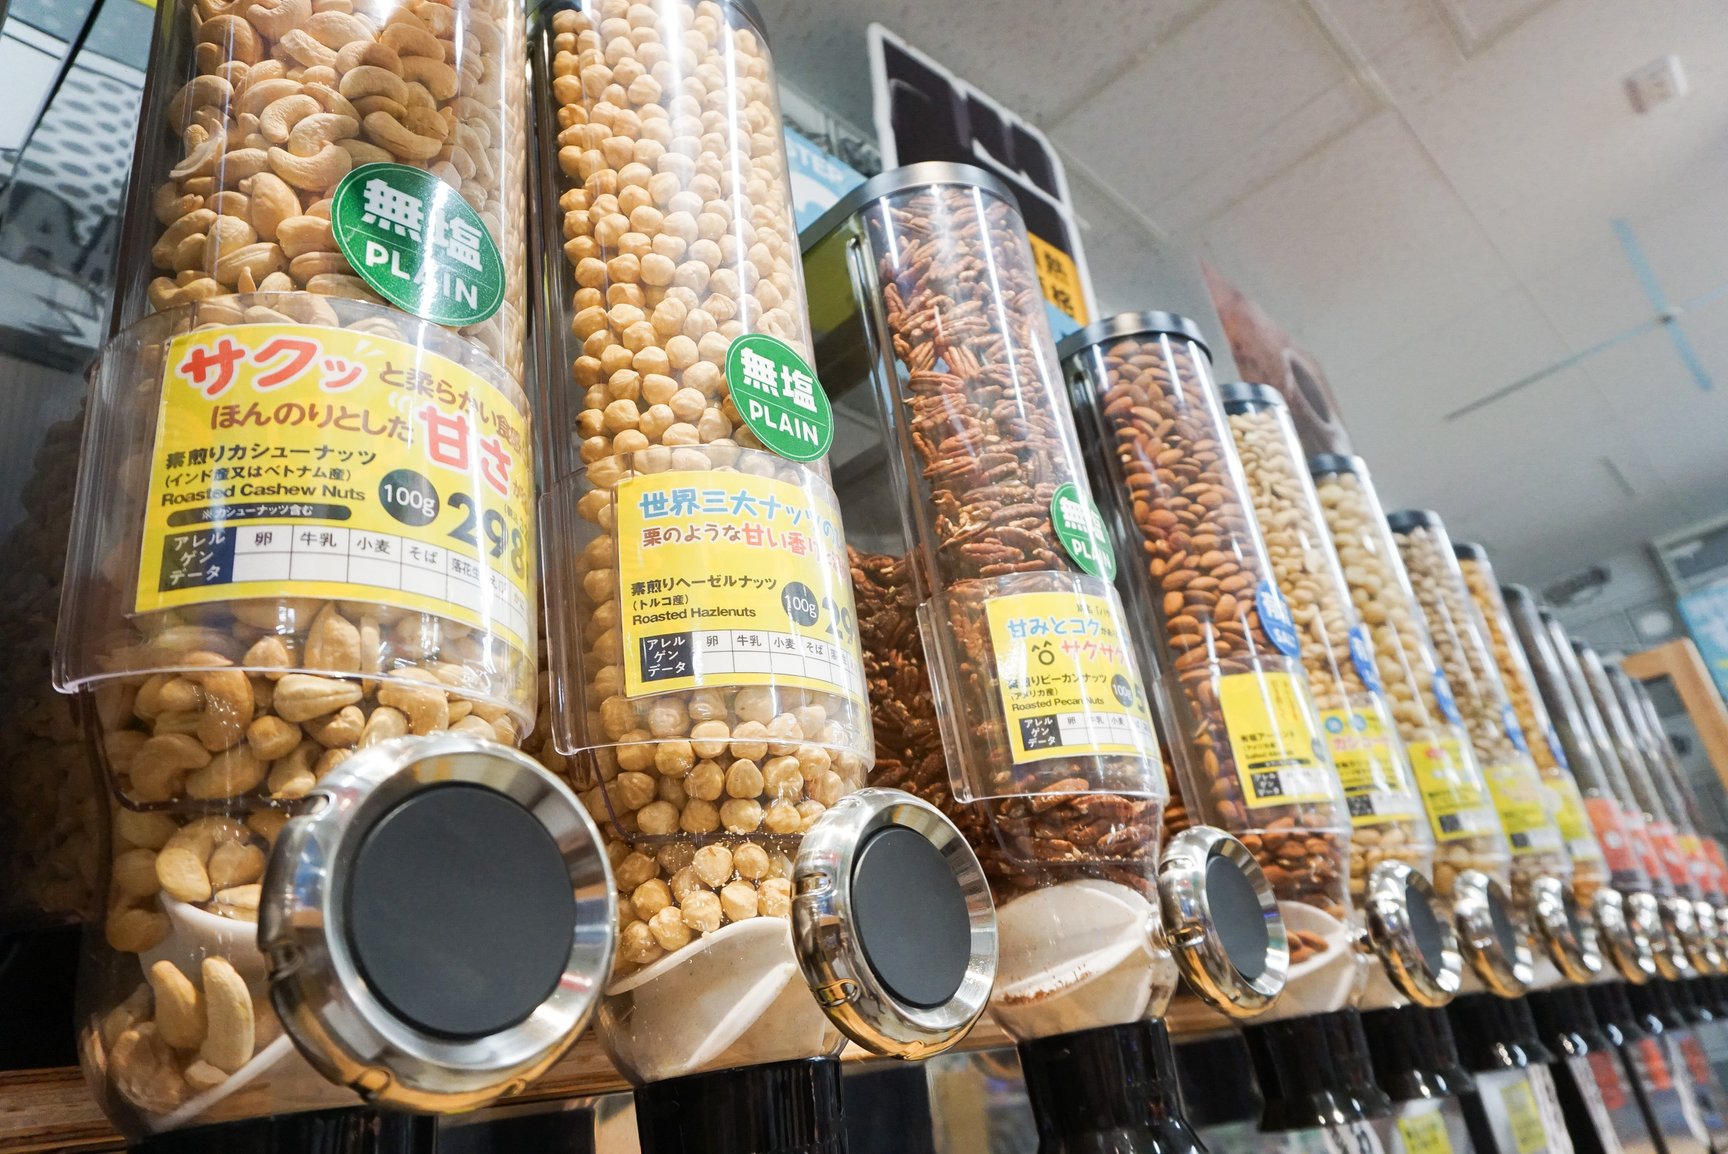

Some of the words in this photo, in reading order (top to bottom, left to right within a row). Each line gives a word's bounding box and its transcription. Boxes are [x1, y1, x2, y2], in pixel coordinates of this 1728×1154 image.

[361, 178, 483, 272] 無塩
[365, 240, 478, 310] PLAIN
[740, 346, 818, 413] 無塩
[749, 399, 819, 446] PLAIN
[166, 443, 377, 470] 素煎りカシューナッツ
[161, 484, 236, 507] Roasted
[240, 483, 310, 498] Cashew
[321, 484, 366, 502] Nuts
[384, 483, 436, 518] 100g
[173, 529, 226, 551] アレル
[255, 531, 273, 547] 卵
[300, 531, 337, 548] 牛乳
[356, 537, 391, 555] 小麦
[409, 546, 439, 564] そば
[180, 549, 214, 567] ゲン
[169, 564, 221, 585] データ
[631, 574, 777, 597] 素煎りヘーゼルナッツ
[632, 594, 689, 611] (トルコ産)
[784, 594, 818, 619] 100g
[632, 608, 688, 626] Roasted
[690, 606, 757, 618] Hazlenuts
[646, 637, 686, 651] アレル
[705, 636, 719, 647] 卵
[736, 635, 762, 648] 牛乳
[773, 637, 796, 651] 小麦
[805, 642, 824, 656] そば
[653, 650, 679, 662] ゲン
[647, 661, 686, 677] データ
[1012, 699, 1052, 712] Roasted
[1024, 716, 1053, 728] アレル
[1031, 727, 1050, 737] ゲン
[1028, 735, 1056, 748] データ
